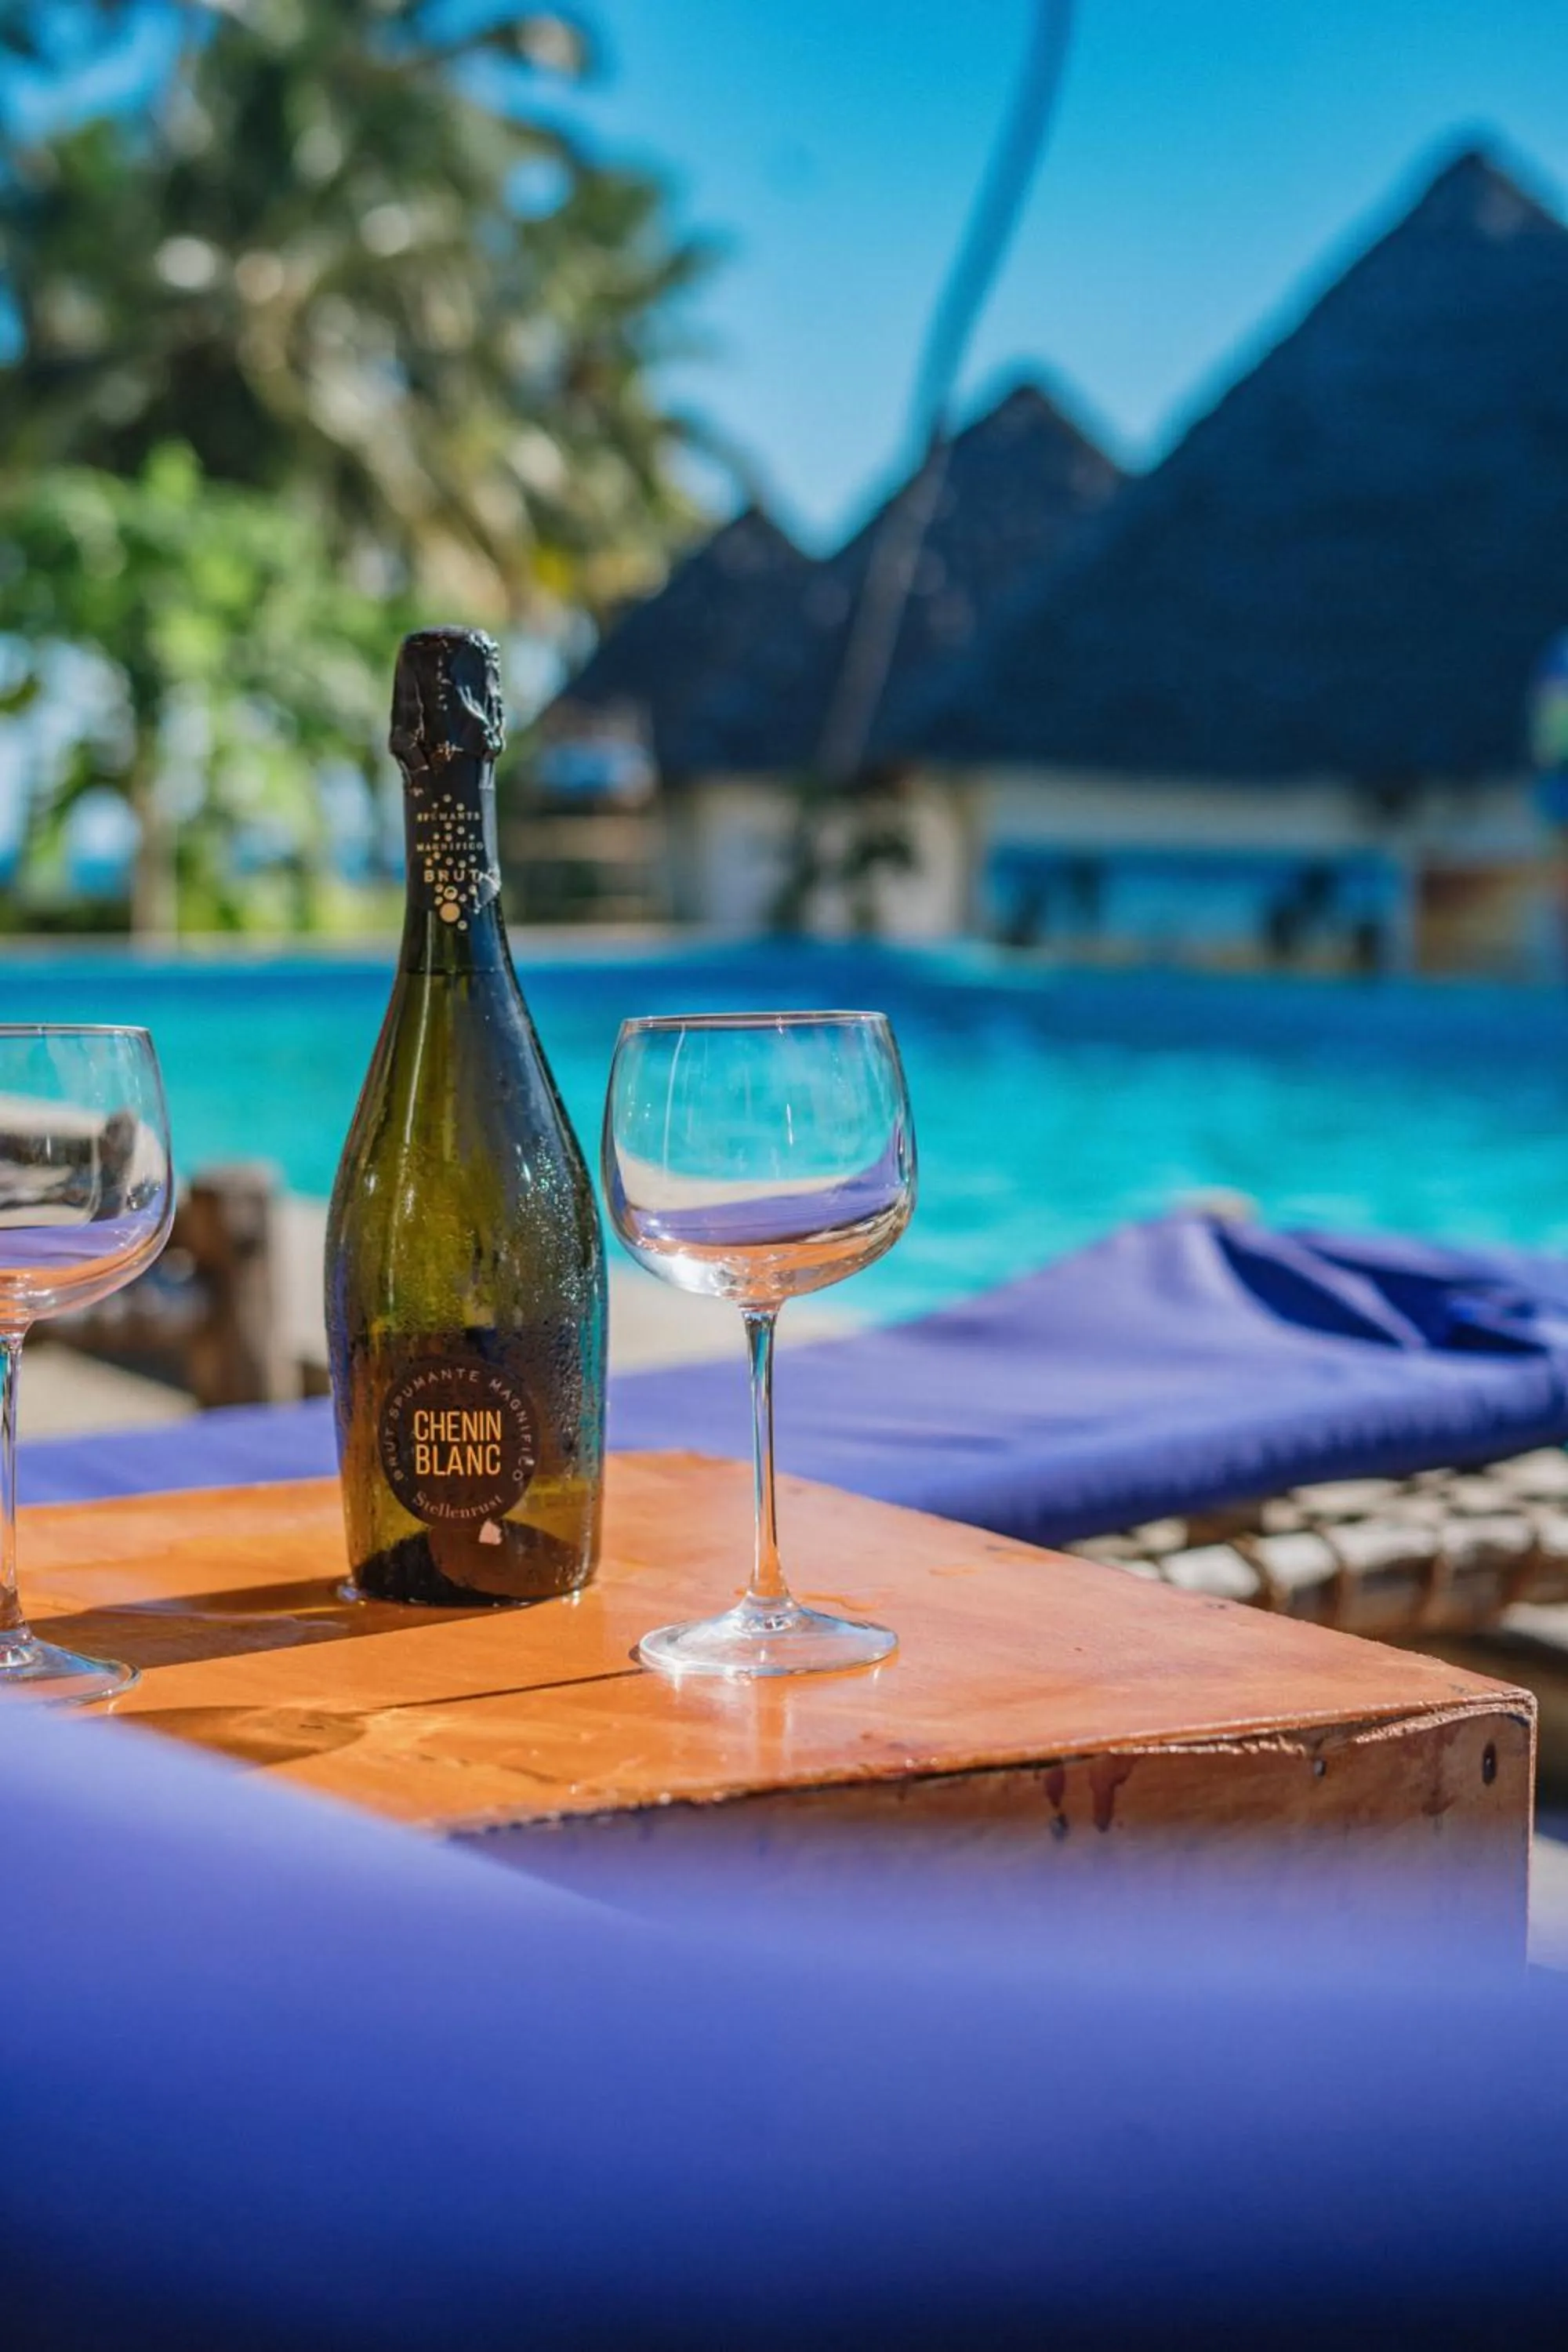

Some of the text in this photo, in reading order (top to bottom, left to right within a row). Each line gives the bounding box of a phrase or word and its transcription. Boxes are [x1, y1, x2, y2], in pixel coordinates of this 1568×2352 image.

[423, 869, 481, 882] BRUT
[390, 1368, 480, 1420] SPUMANTE
[489, 1378, 535, 1481] MAGNIFICO
[414, 1409, 502, 1443] CHENIN
[416, 1443, 502, 1476] BLANC
[412, 1490, 503, 1519] Stellenrust
